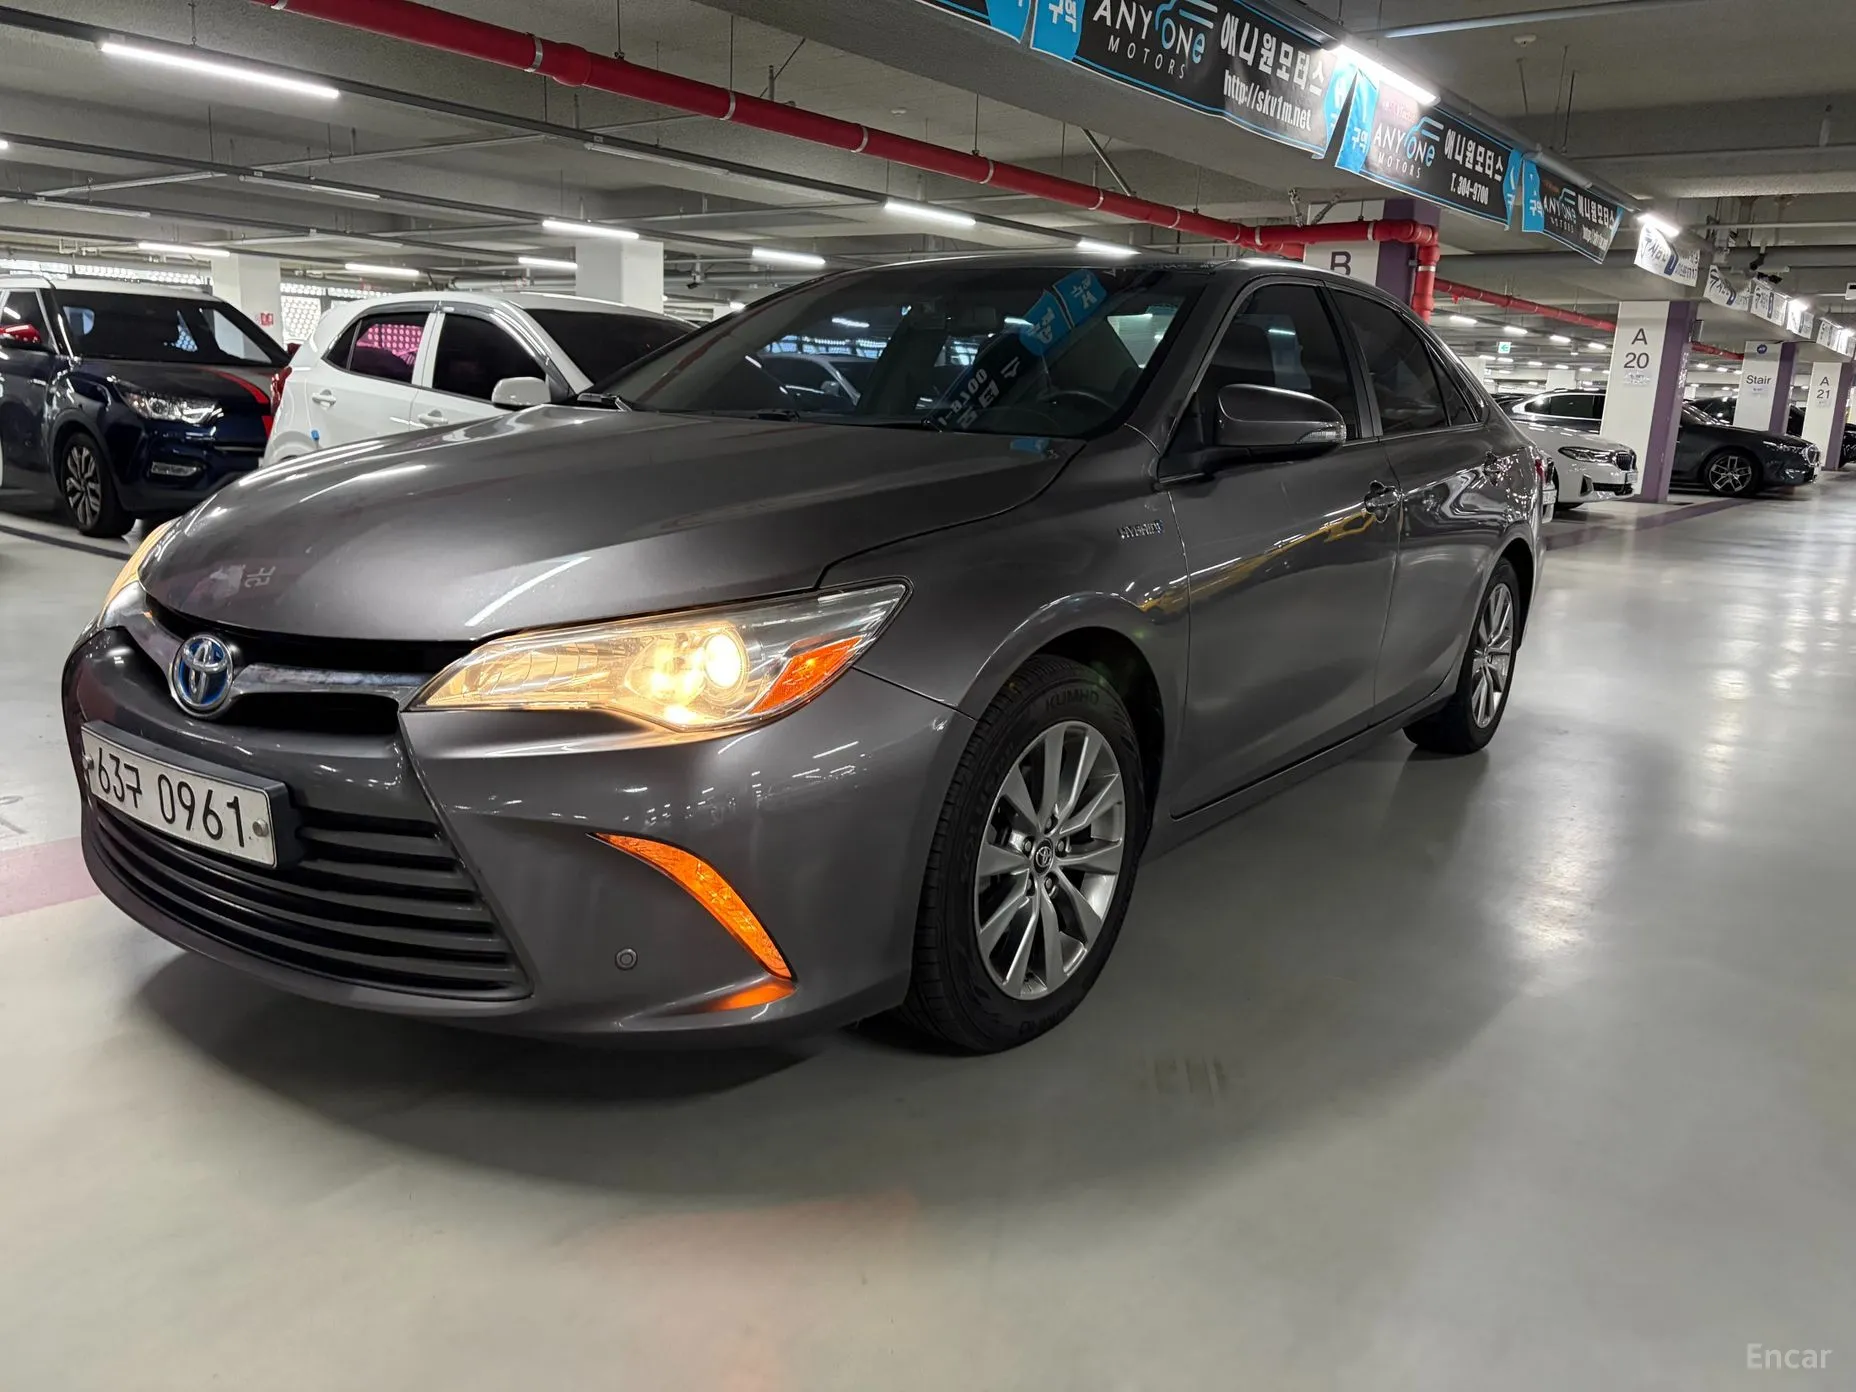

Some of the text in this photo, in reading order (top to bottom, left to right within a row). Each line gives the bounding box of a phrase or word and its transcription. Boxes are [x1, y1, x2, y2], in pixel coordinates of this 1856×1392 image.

[1107, 35, 1186, 79] MOTORS
[1220, 12, 1325, 96] 애니원모터스
[1378, 151, 1421, 179] MOTORS
[1444, 128, 1504, 182] 애니원모터스
[1330, 250, 1351, 276] B
[1631, 327, 1648, 345] A
[1623, 352, 1649, 369] 20
[1746, 374, 1772, 385] Stair
[1819, 376, 1830, 386] A
[1816, 390, 1831, 399] 21
[98, 747, 245, 848] 63구 0961
